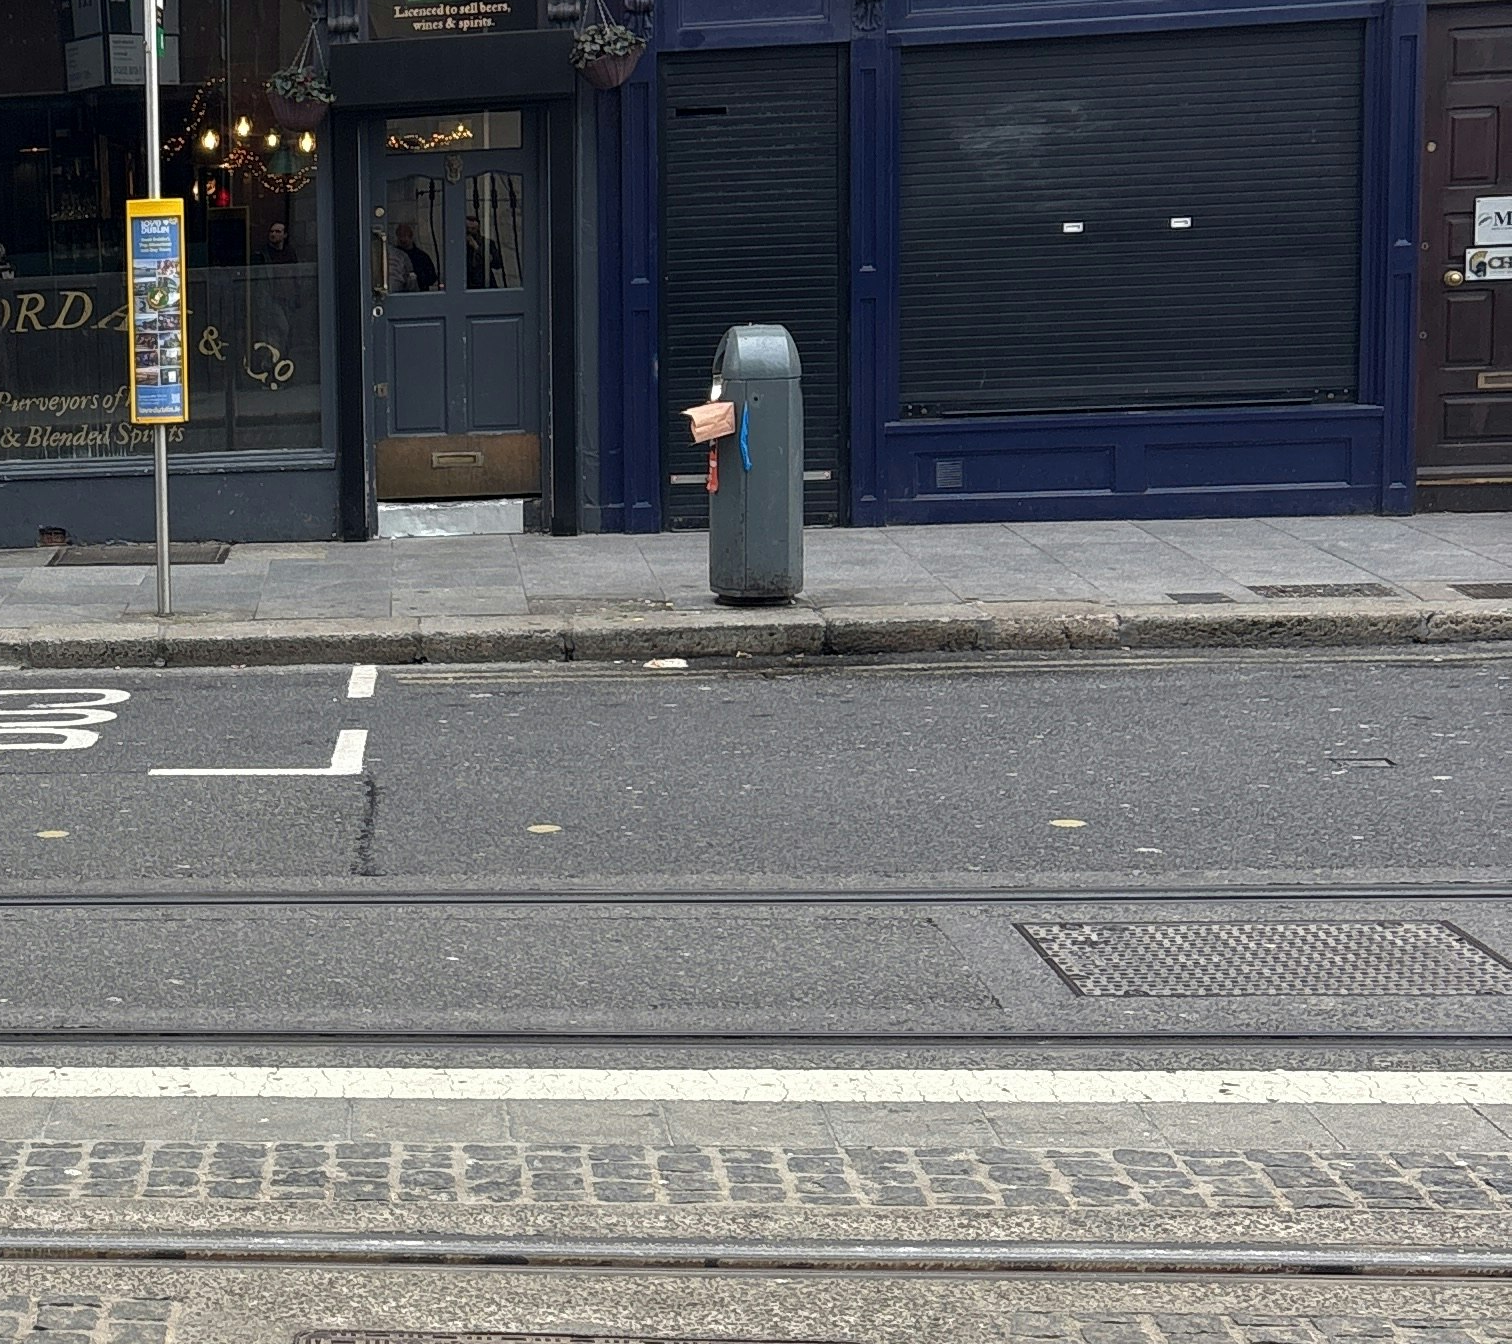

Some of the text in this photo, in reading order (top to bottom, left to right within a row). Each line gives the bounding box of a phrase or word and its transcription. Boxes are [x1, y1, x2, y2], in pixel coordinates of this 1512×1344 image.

[459, 1, 479, 14] sell
[445, 17, 457, 29] &
[198, 325, 229, 361] &
[102, 385, 130, 414] of
[0, 426, 21, 449] &
[25, 423, 112, 449] Blended
